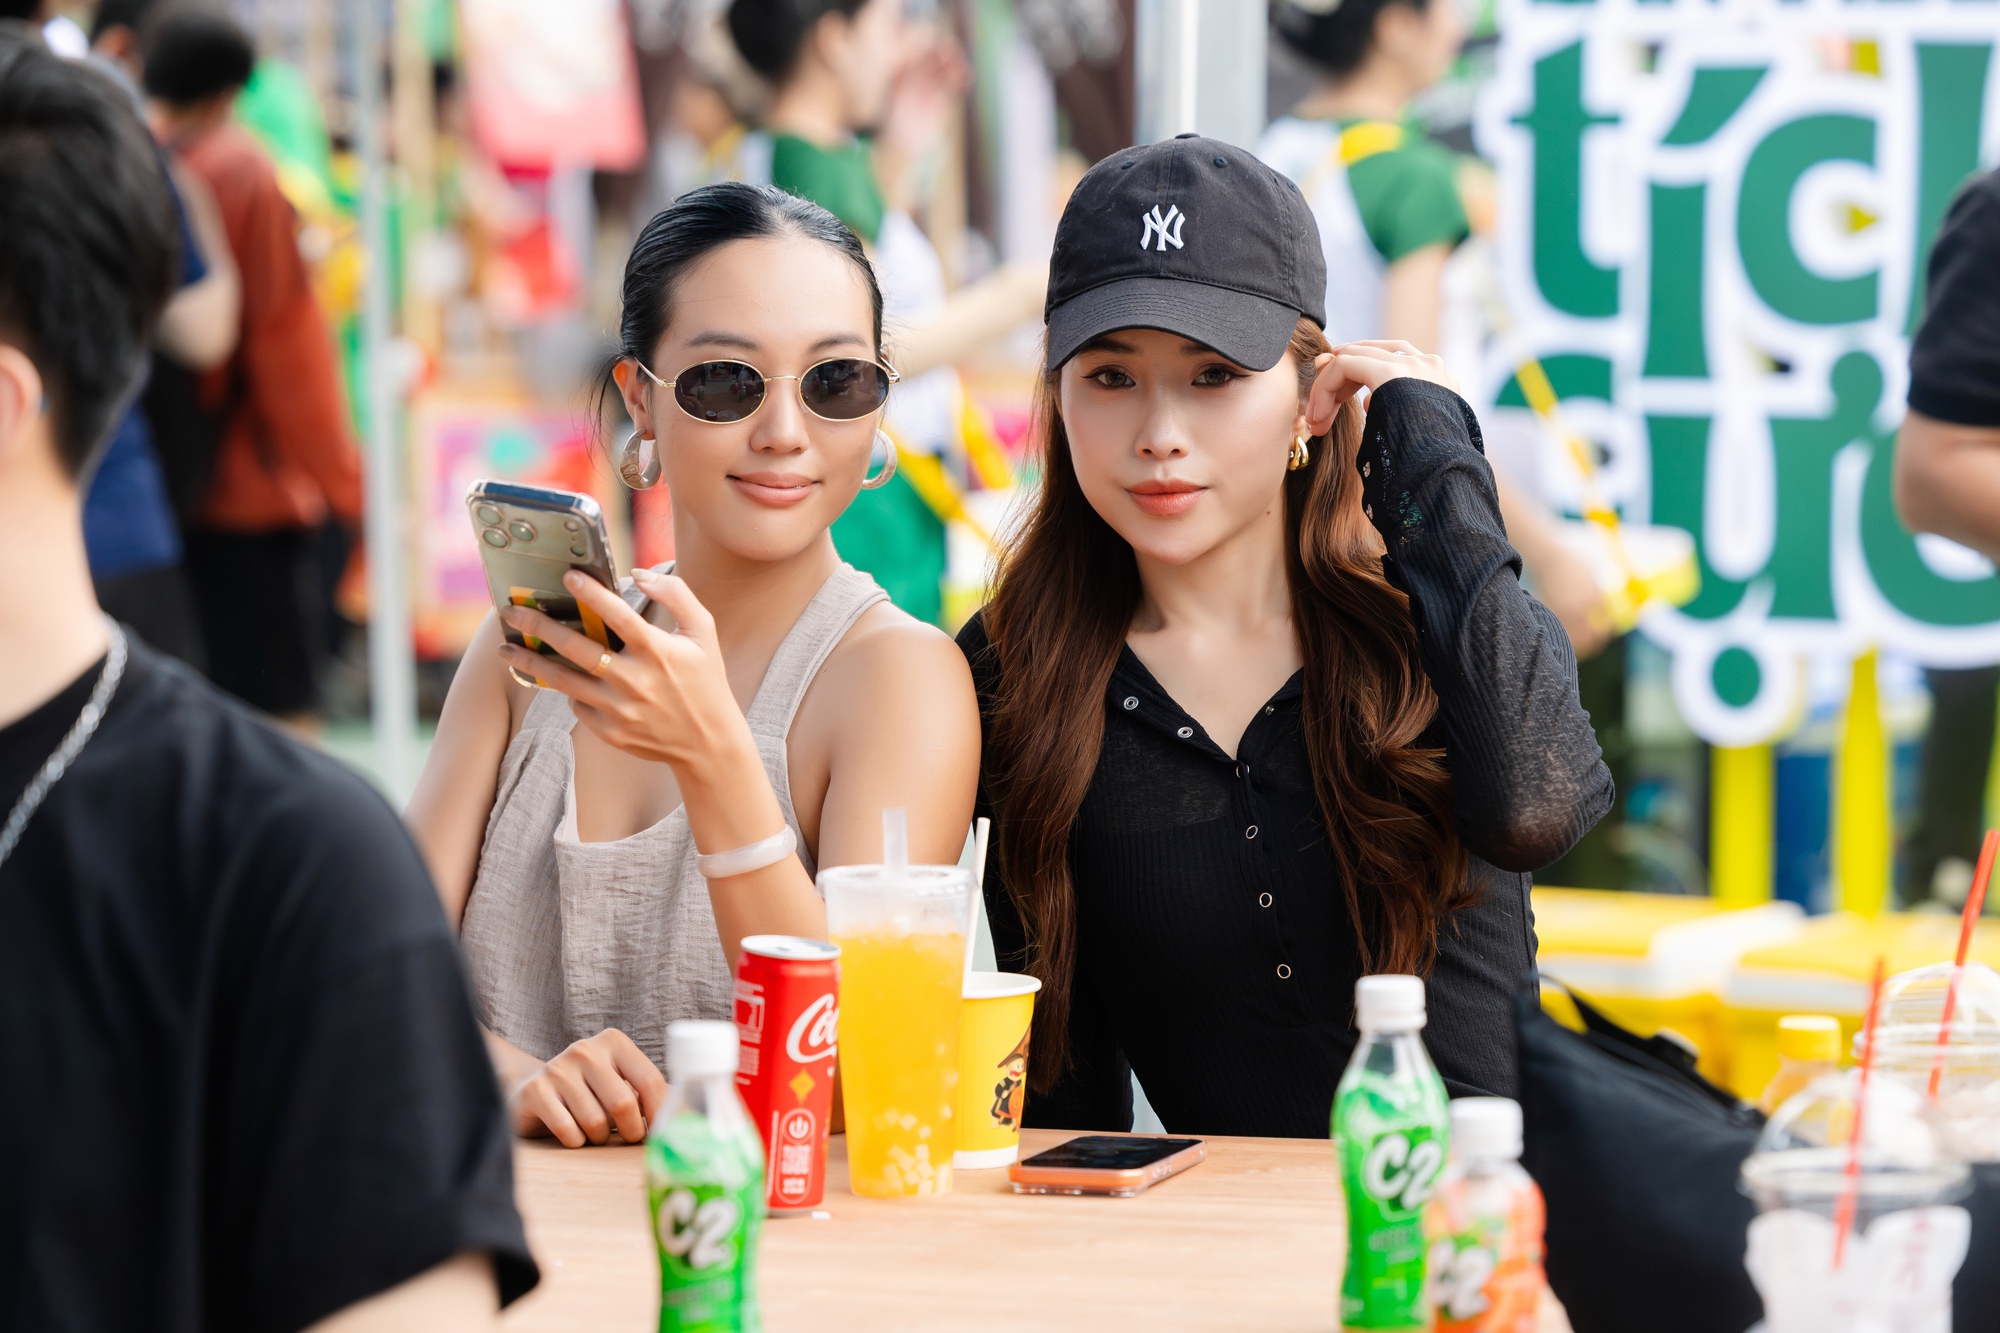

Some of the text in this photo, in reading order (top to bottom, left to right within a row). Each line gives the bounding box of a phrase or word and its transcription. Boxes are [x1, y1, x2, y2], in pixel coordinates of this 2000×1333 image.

[1140, 204, 1186, 251] NY
[1365, 1133, 1442, 1211] C2
[658, 1188, 738, 1270] C2
